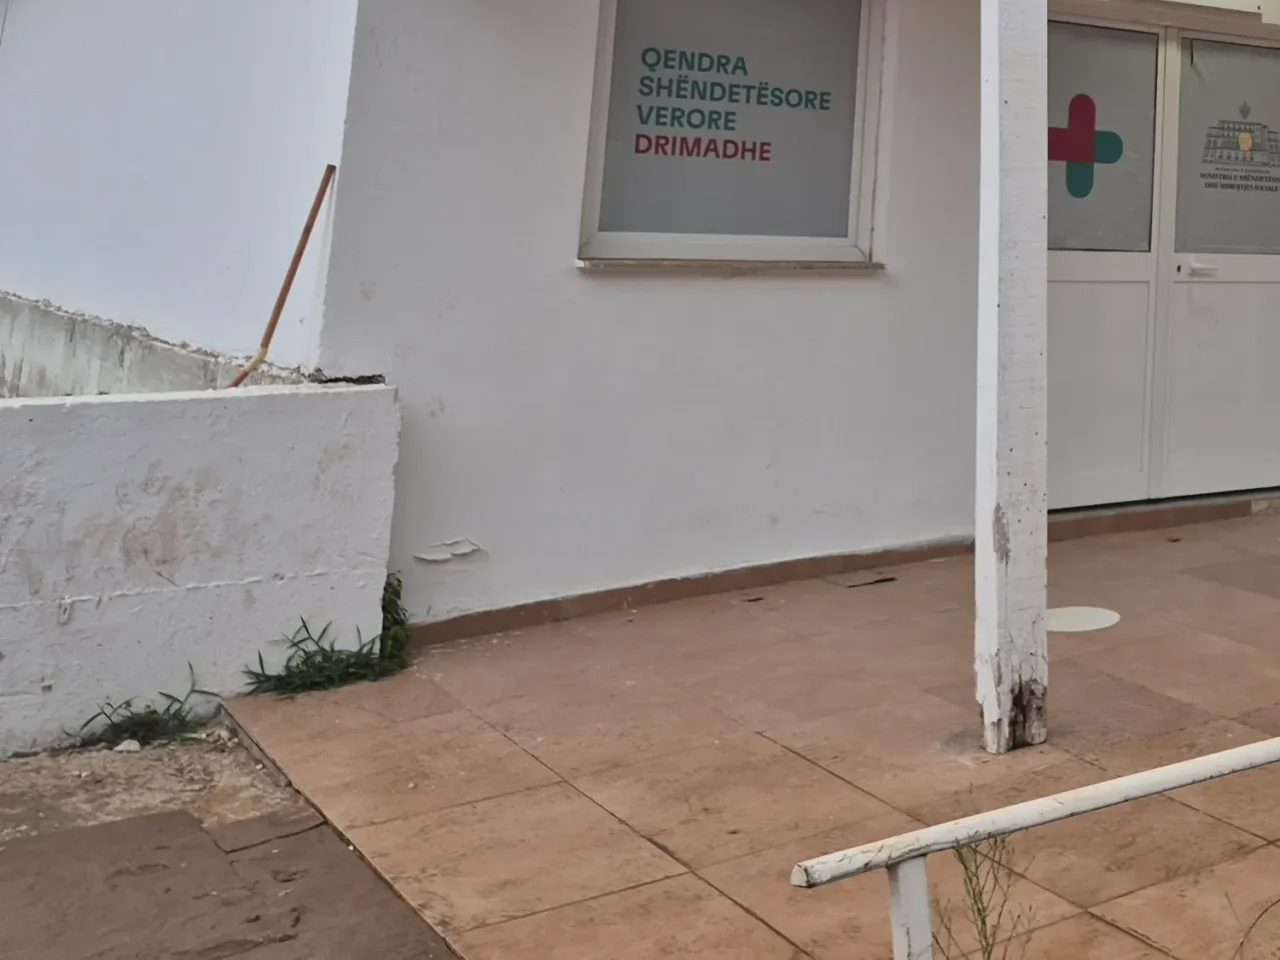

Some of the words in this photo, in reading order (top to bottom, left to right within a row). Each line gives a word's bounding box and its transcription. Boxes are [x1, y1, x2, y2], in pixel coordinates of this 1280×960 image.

[641, 47, 748, 76] QENDRA
[638, 74, 831, 110] SHËNDETËSORE
[636, 104, 737, 131] VERORE
[634, 134, 771, 161] DRIMADHE
[1200, 172, 1232, 180] MINISTRIA
